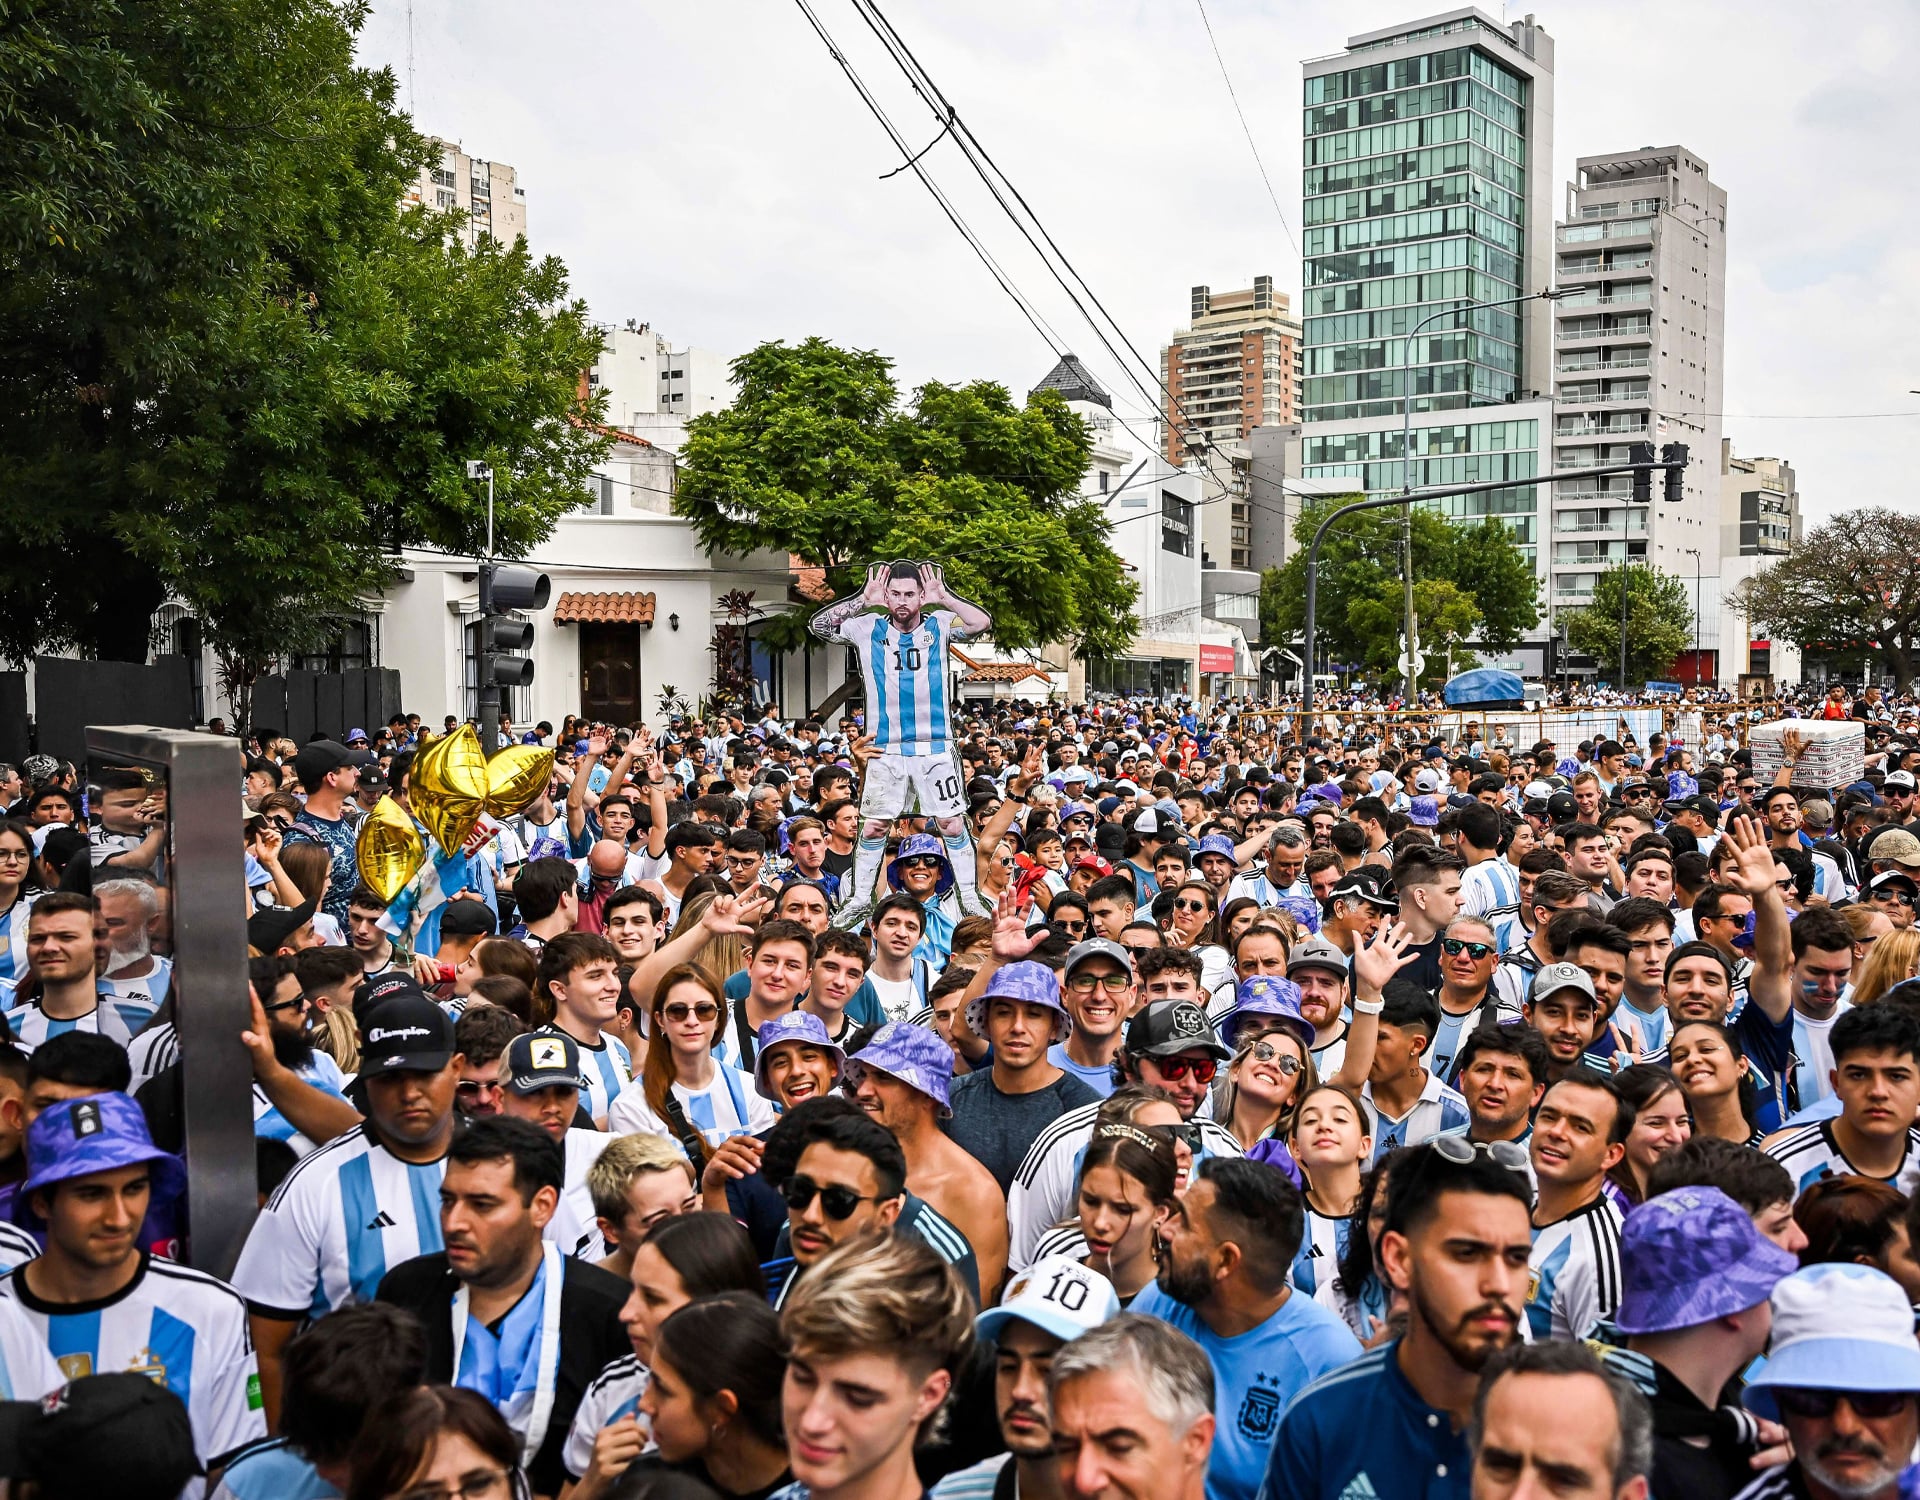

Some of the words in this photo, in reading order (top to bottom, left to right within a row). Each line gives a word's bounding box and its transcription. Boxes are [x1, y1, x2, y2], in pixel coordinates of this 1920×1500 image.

[892, 647, 922, 671] 10
[934, 775, 960, 802] 10
[1180, 1013, 1199, 1024] LC
[369, 1025, 431, 1043] Champion
[1042, 1272, 1090, 1311] 10
